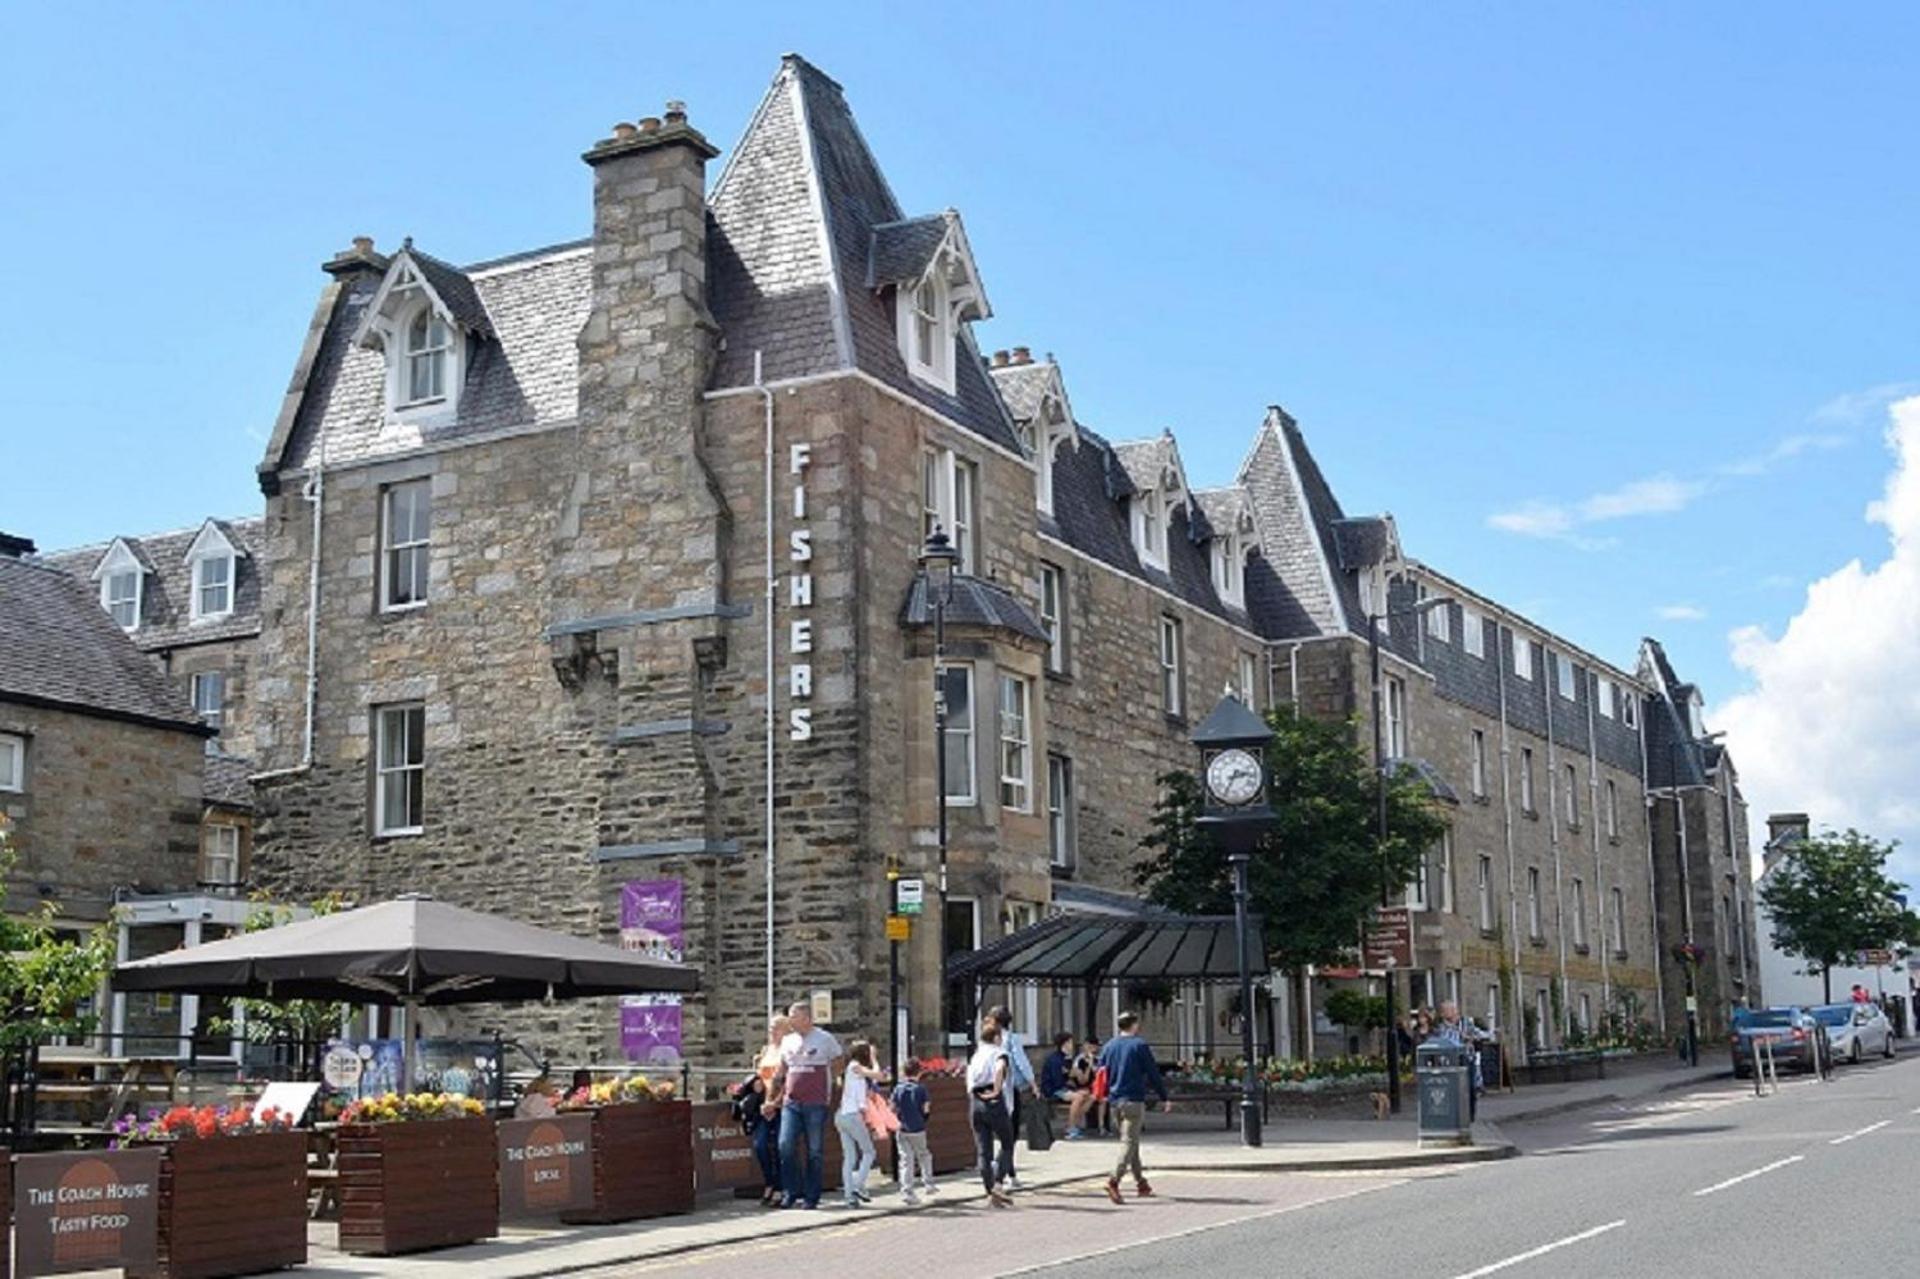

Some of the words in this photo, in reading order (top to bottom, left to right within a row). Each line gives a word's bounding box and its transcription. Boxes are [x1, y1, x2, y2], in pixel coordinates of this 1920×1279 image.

[790, 444, 812, 741] FISHERS
[28, 1188, 54, 1205] THE
[58, 1187, 103, 1202] COACH
[107, 1183, 149, 1199] HOUSE
[50, 1216, 89, 1233] TASTY
[91, 1214, 130, 1229] FOOD
